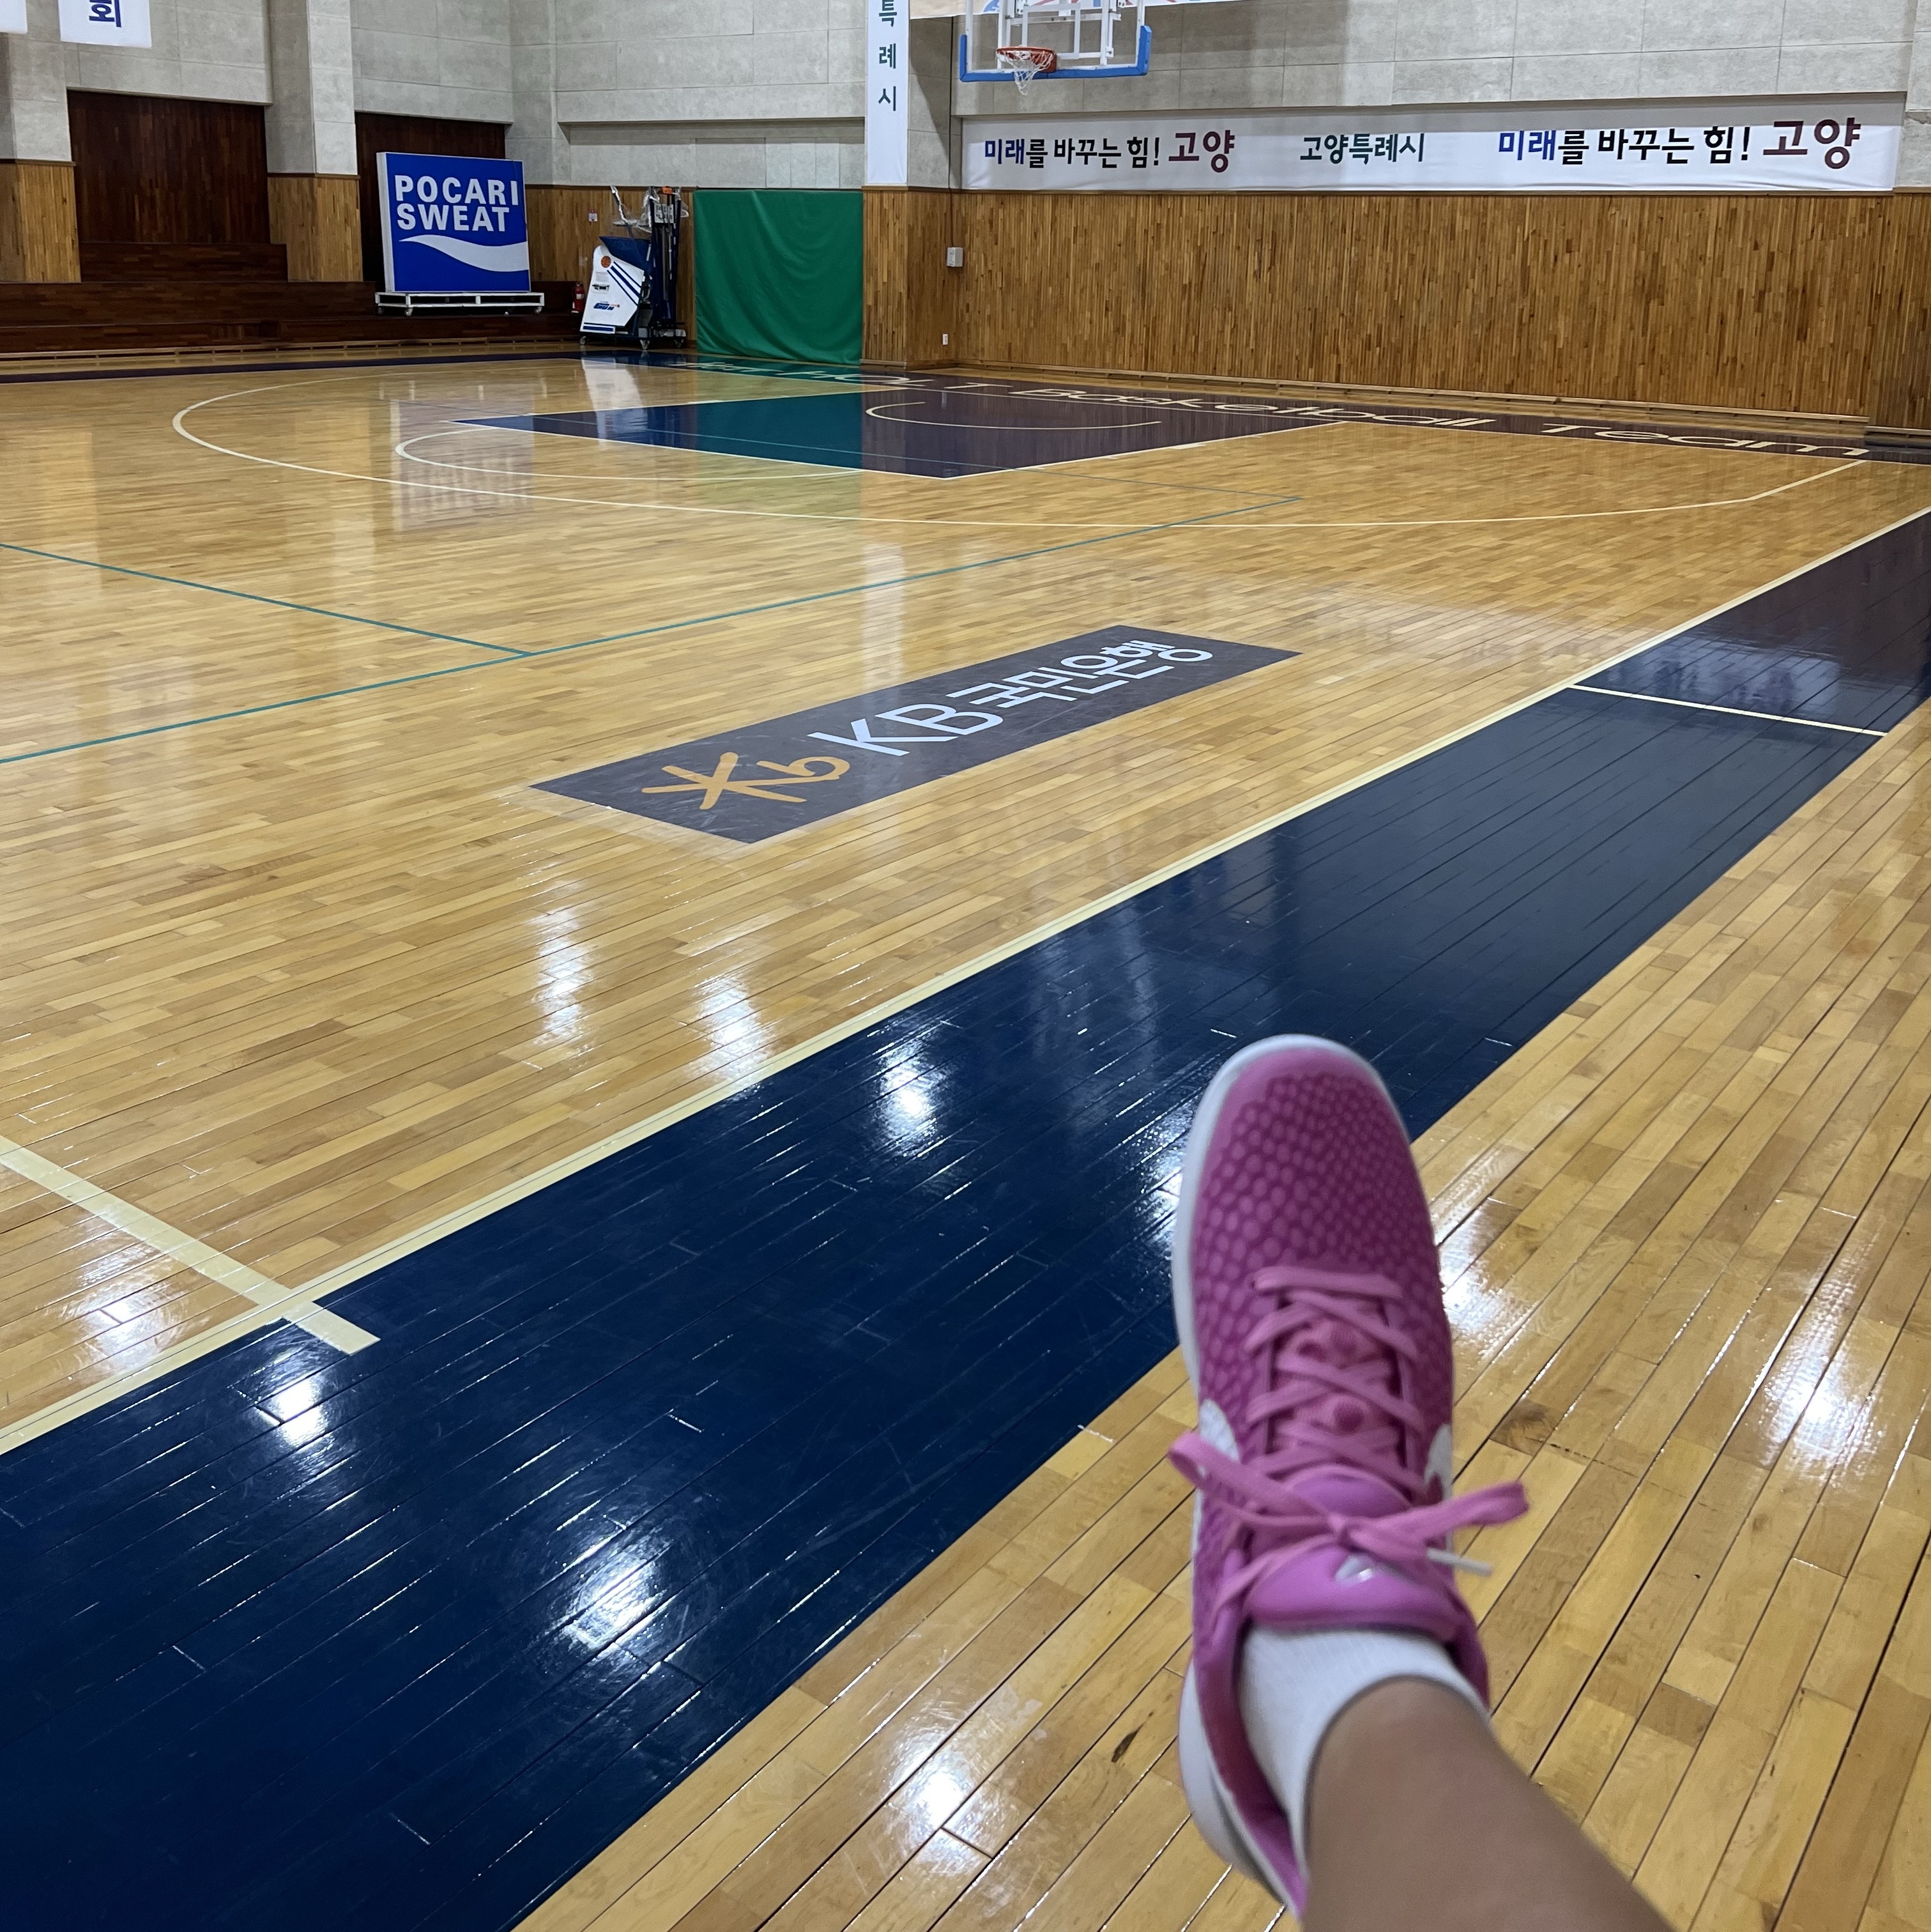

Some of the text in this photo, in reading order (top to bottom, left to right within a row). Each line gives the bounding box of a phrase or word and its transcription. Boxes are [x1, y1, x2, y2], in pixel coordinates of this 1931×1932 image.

[984, 130, 1235, 172] 미래를 바꾸는 힘! 고양
[1300, 133, 1424, 164] 고양특례시
[1498, 117, 1861, 169] 미래를 바꾸는 힘! 고양
[395, 175, 519, 205] POCARI
[397, 203, 510, 232] SWEAT
[775, 371, 1870, 456] HOLT Basketball Team
[807, 640, 1213, 756] KB국민은행
